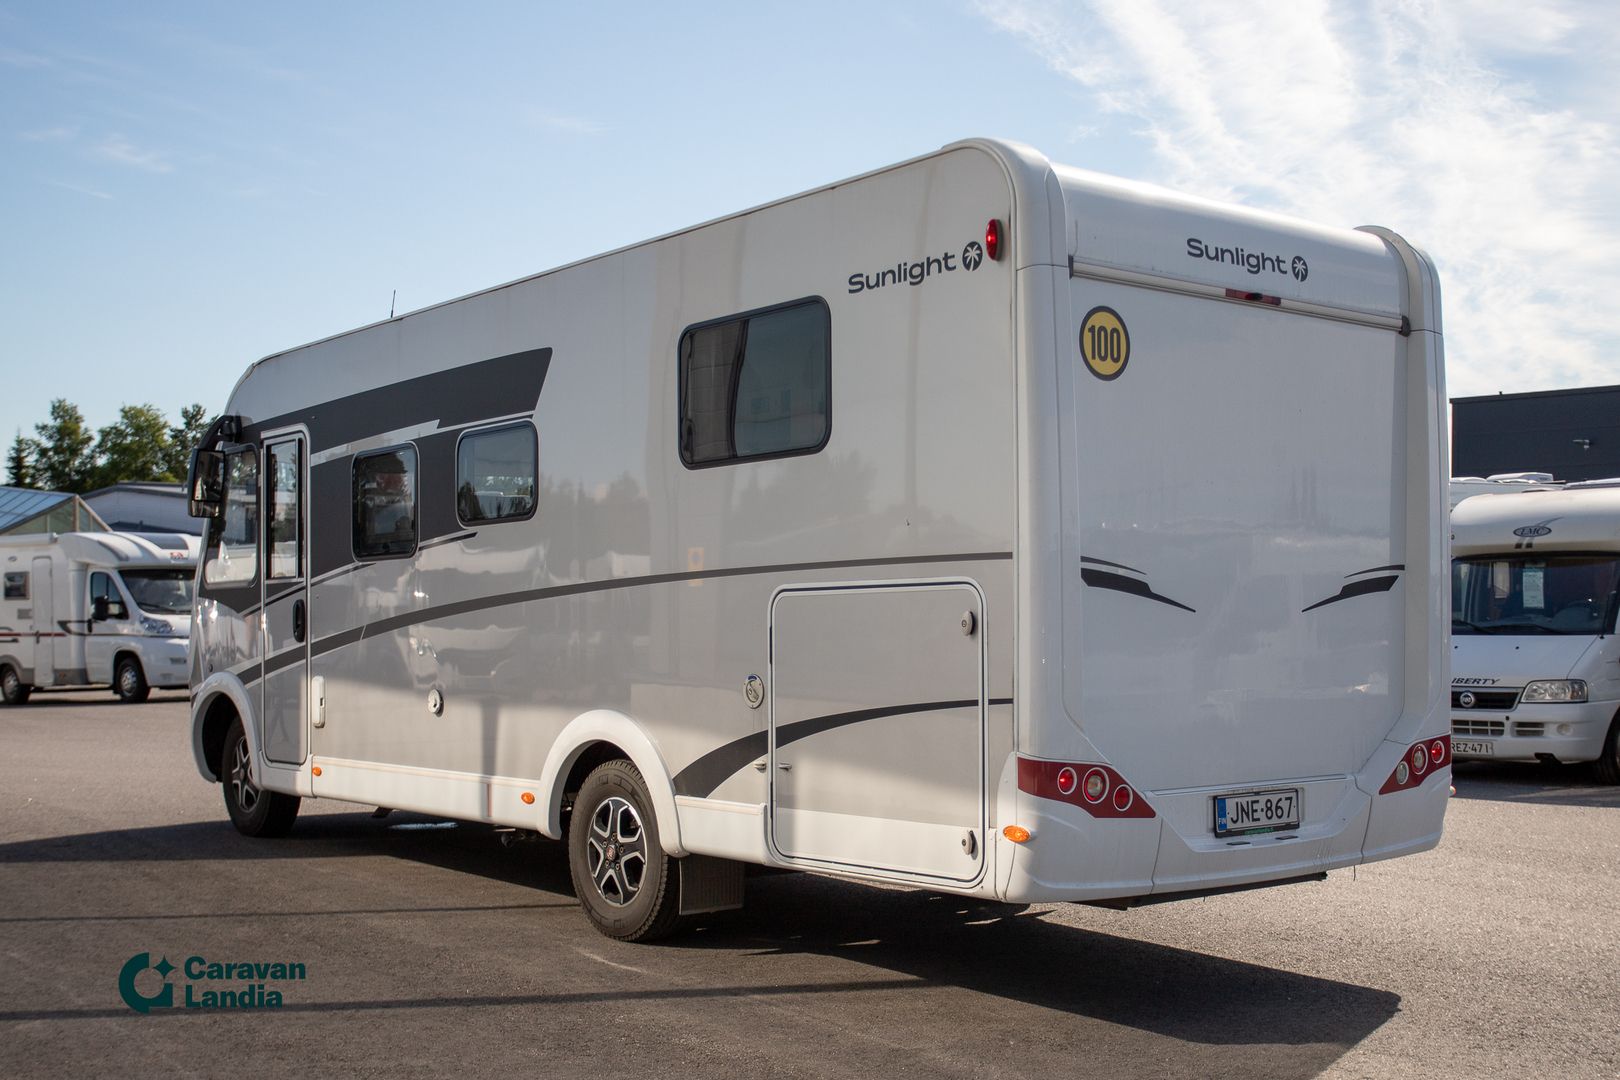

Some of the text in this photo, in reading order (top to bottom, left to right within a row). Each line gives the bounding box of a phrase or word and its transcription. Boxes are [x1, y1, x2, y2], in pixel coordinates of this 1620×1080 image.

[848, 252, 957, 294] Sunlight
[1186, 238, 1288, 275] Sunlight
[1087, 324, 1122, 364] 100
[1230, 796, 1293, 824] JNE-867
